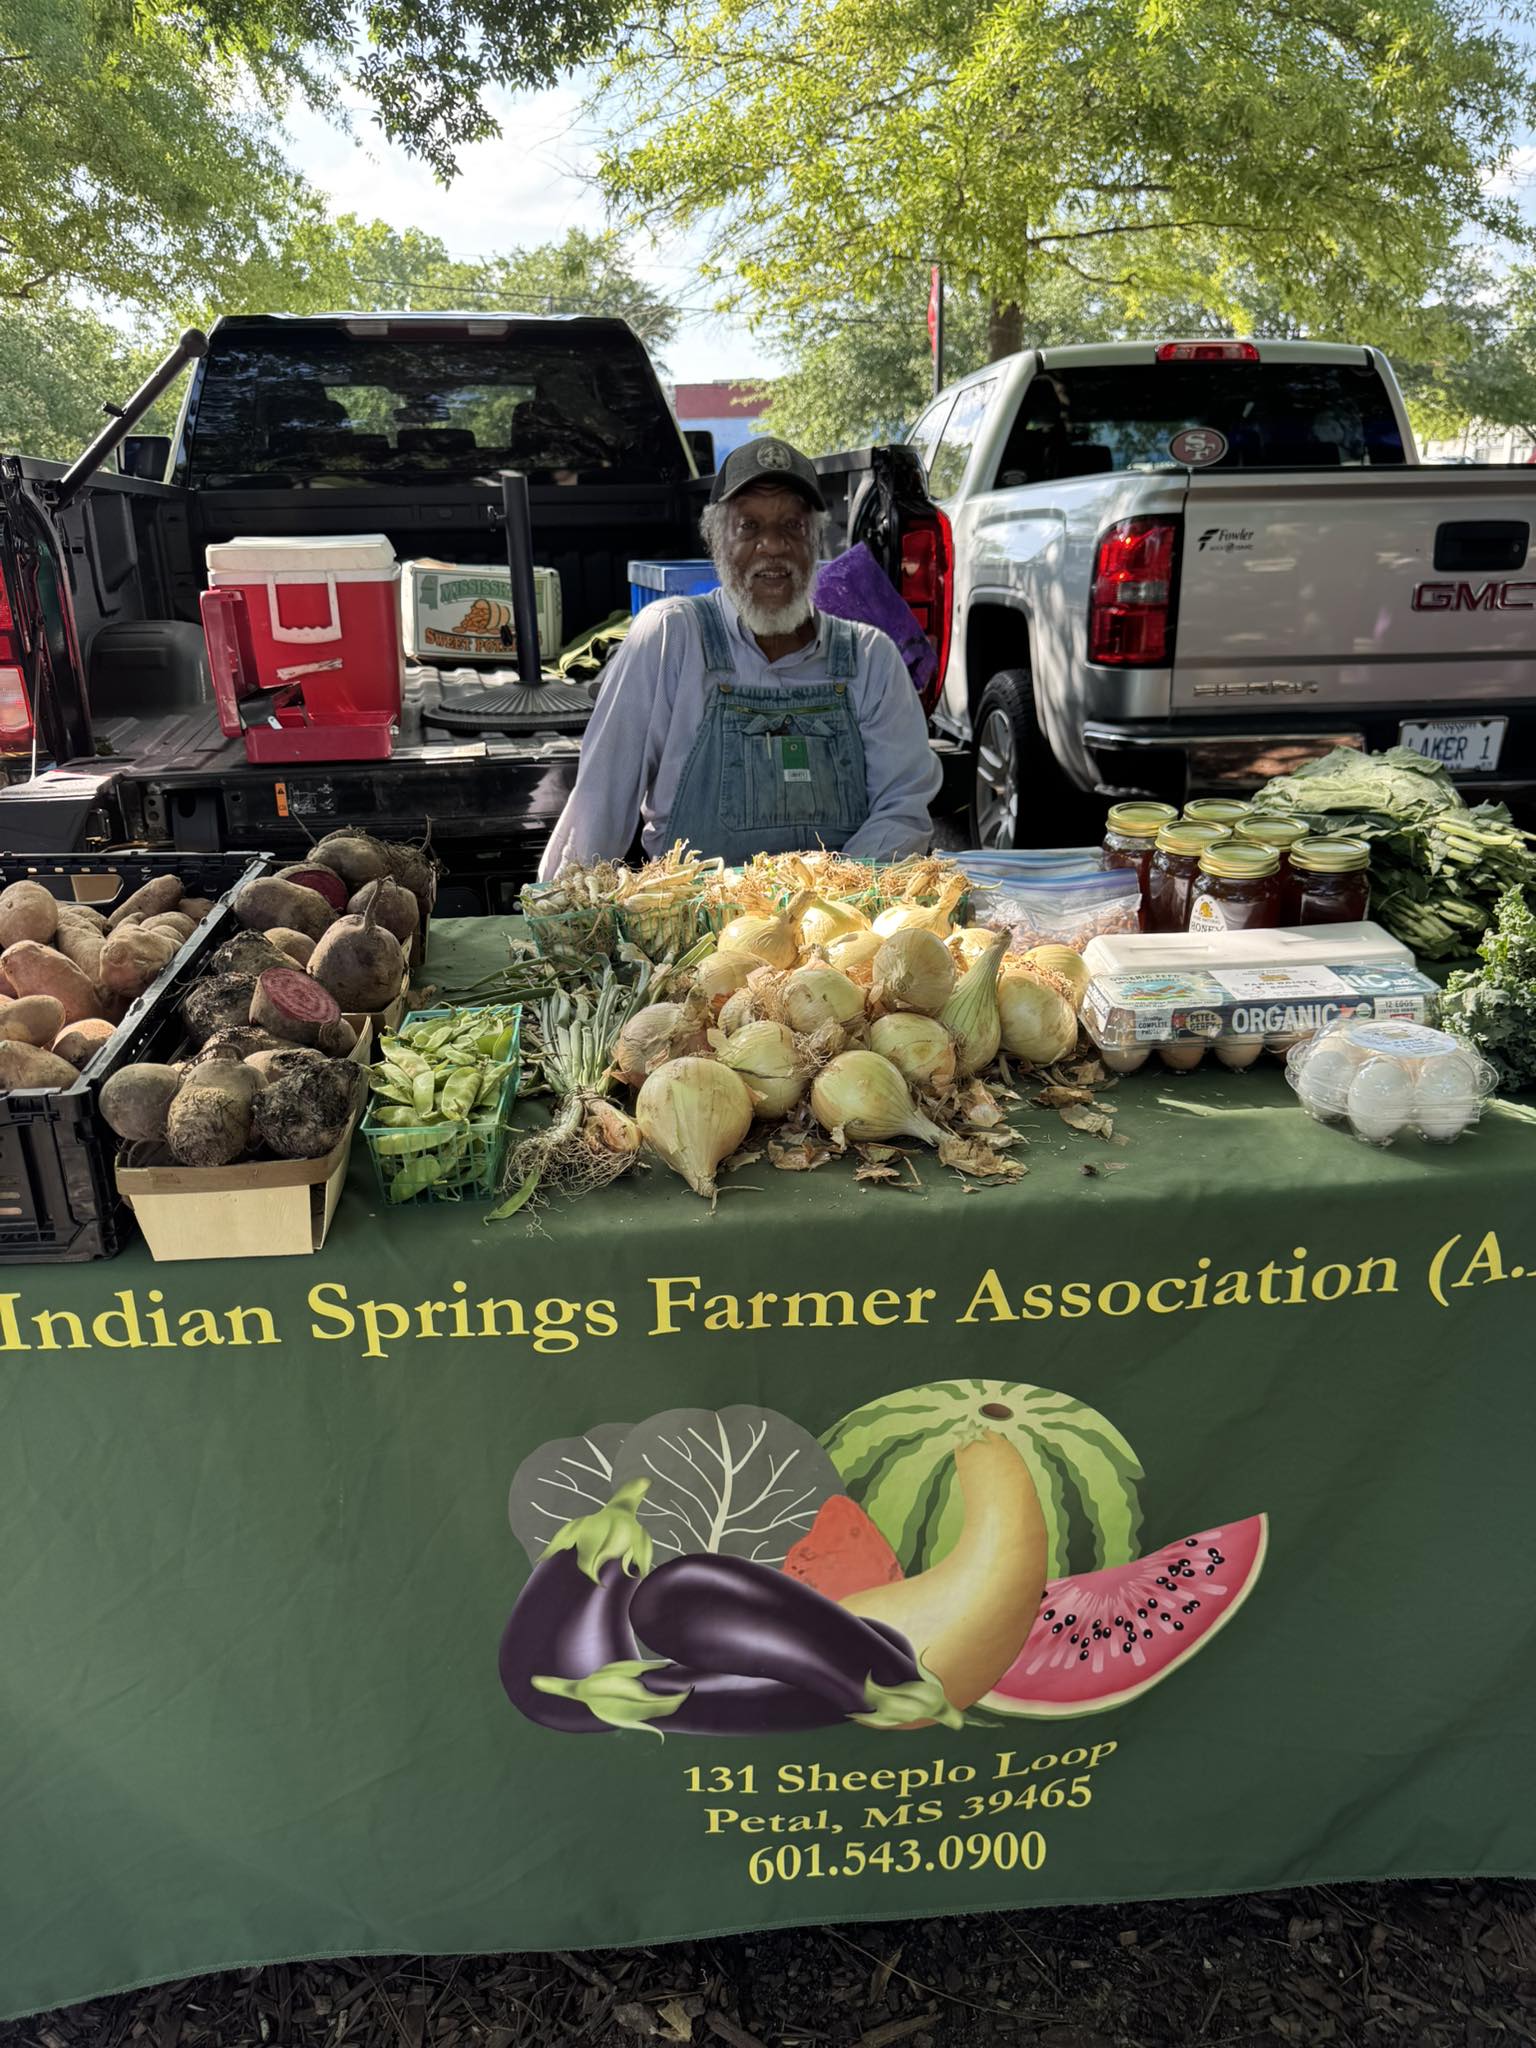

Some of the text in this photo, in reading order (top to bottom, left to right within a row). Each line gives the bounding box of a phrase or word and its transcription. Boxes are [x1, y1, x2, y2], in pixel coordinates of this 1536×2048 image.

[1219, 528, 1254, 541] Fowler
[440, 578, 514, 604] MISSISSI
[1411, 580, 1536, 611] GMC
[425, 627, 472, 650] SWEET
[1231, 1003, 1339, 1034] ORGANIC
[0, 1230, 1536, 1358] Indian Springs Farmer Association (A.
[683, 1740, 1118, 1798] 131 Sheeplo Loop
[704, 1775, 1092, 1834] Petal, MS 39465
[748, 1830, 1047, 1885] 601.543.0900
